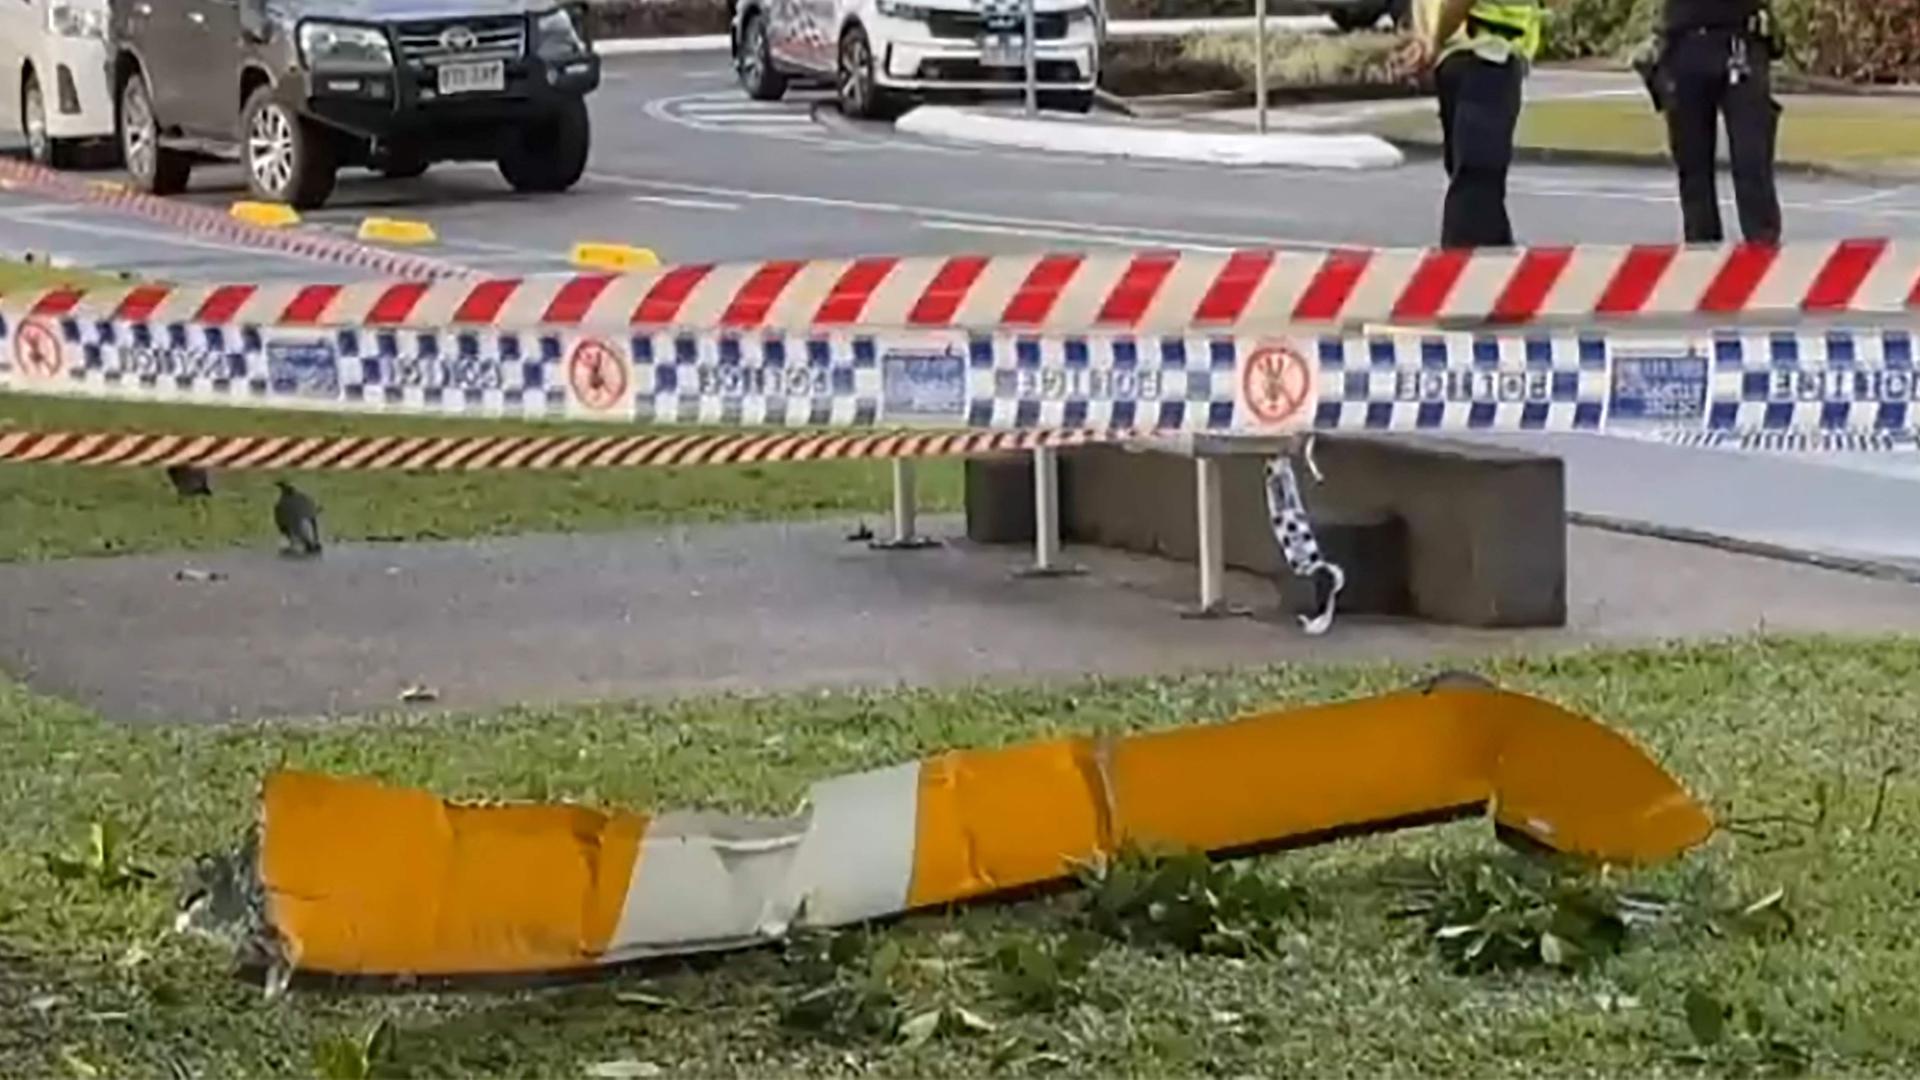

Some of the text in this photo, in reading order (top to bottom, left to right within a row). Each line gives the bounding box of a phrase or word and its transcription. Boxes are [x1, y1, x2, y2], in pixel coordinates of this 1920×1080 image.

[699, 364, 826, 395] POLICE
[1018, 370, 1163, 400] POLICE
[1398, 370, 1546, 400] POLICE
[1775, 370, 1920, 400] OLICE
